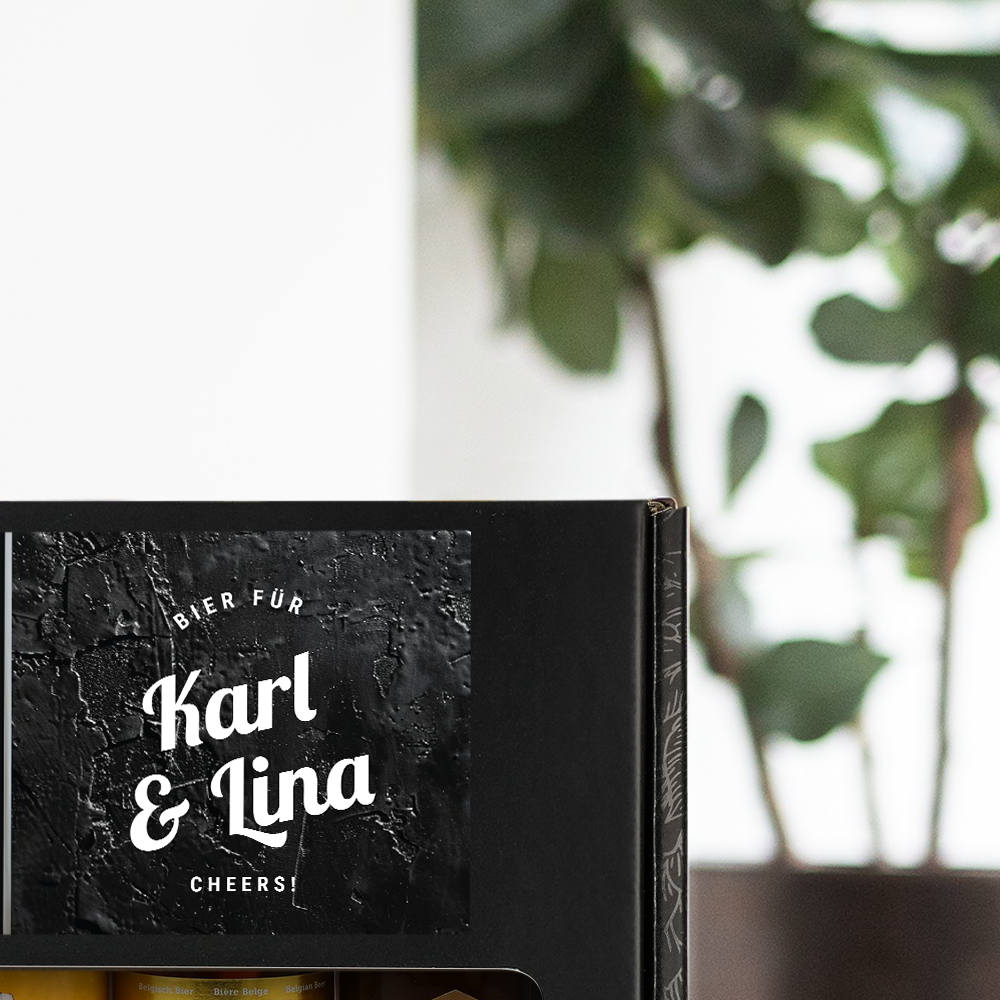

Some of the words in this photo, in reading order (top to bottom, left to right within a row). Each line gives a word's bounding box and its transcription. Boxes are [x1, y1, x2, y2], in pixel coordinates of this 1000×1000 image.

[173, 591, 235, 631] BIER
[253, 588, 303, 615] FÜR
[142, 651, 317, 751] Karl
[130, 774, 190, 852] &
[210, 755, 376, 848] Lina
[190, 876, 296, 892] CHEERS!
[138, 982, 172, 994] Belgisch
[175, 986, 194, 996] Bier
[213, 987, 239, 996] Bière
[242, 987, 269, 996] Belge
[286, 982, 313, 994] Belgian
